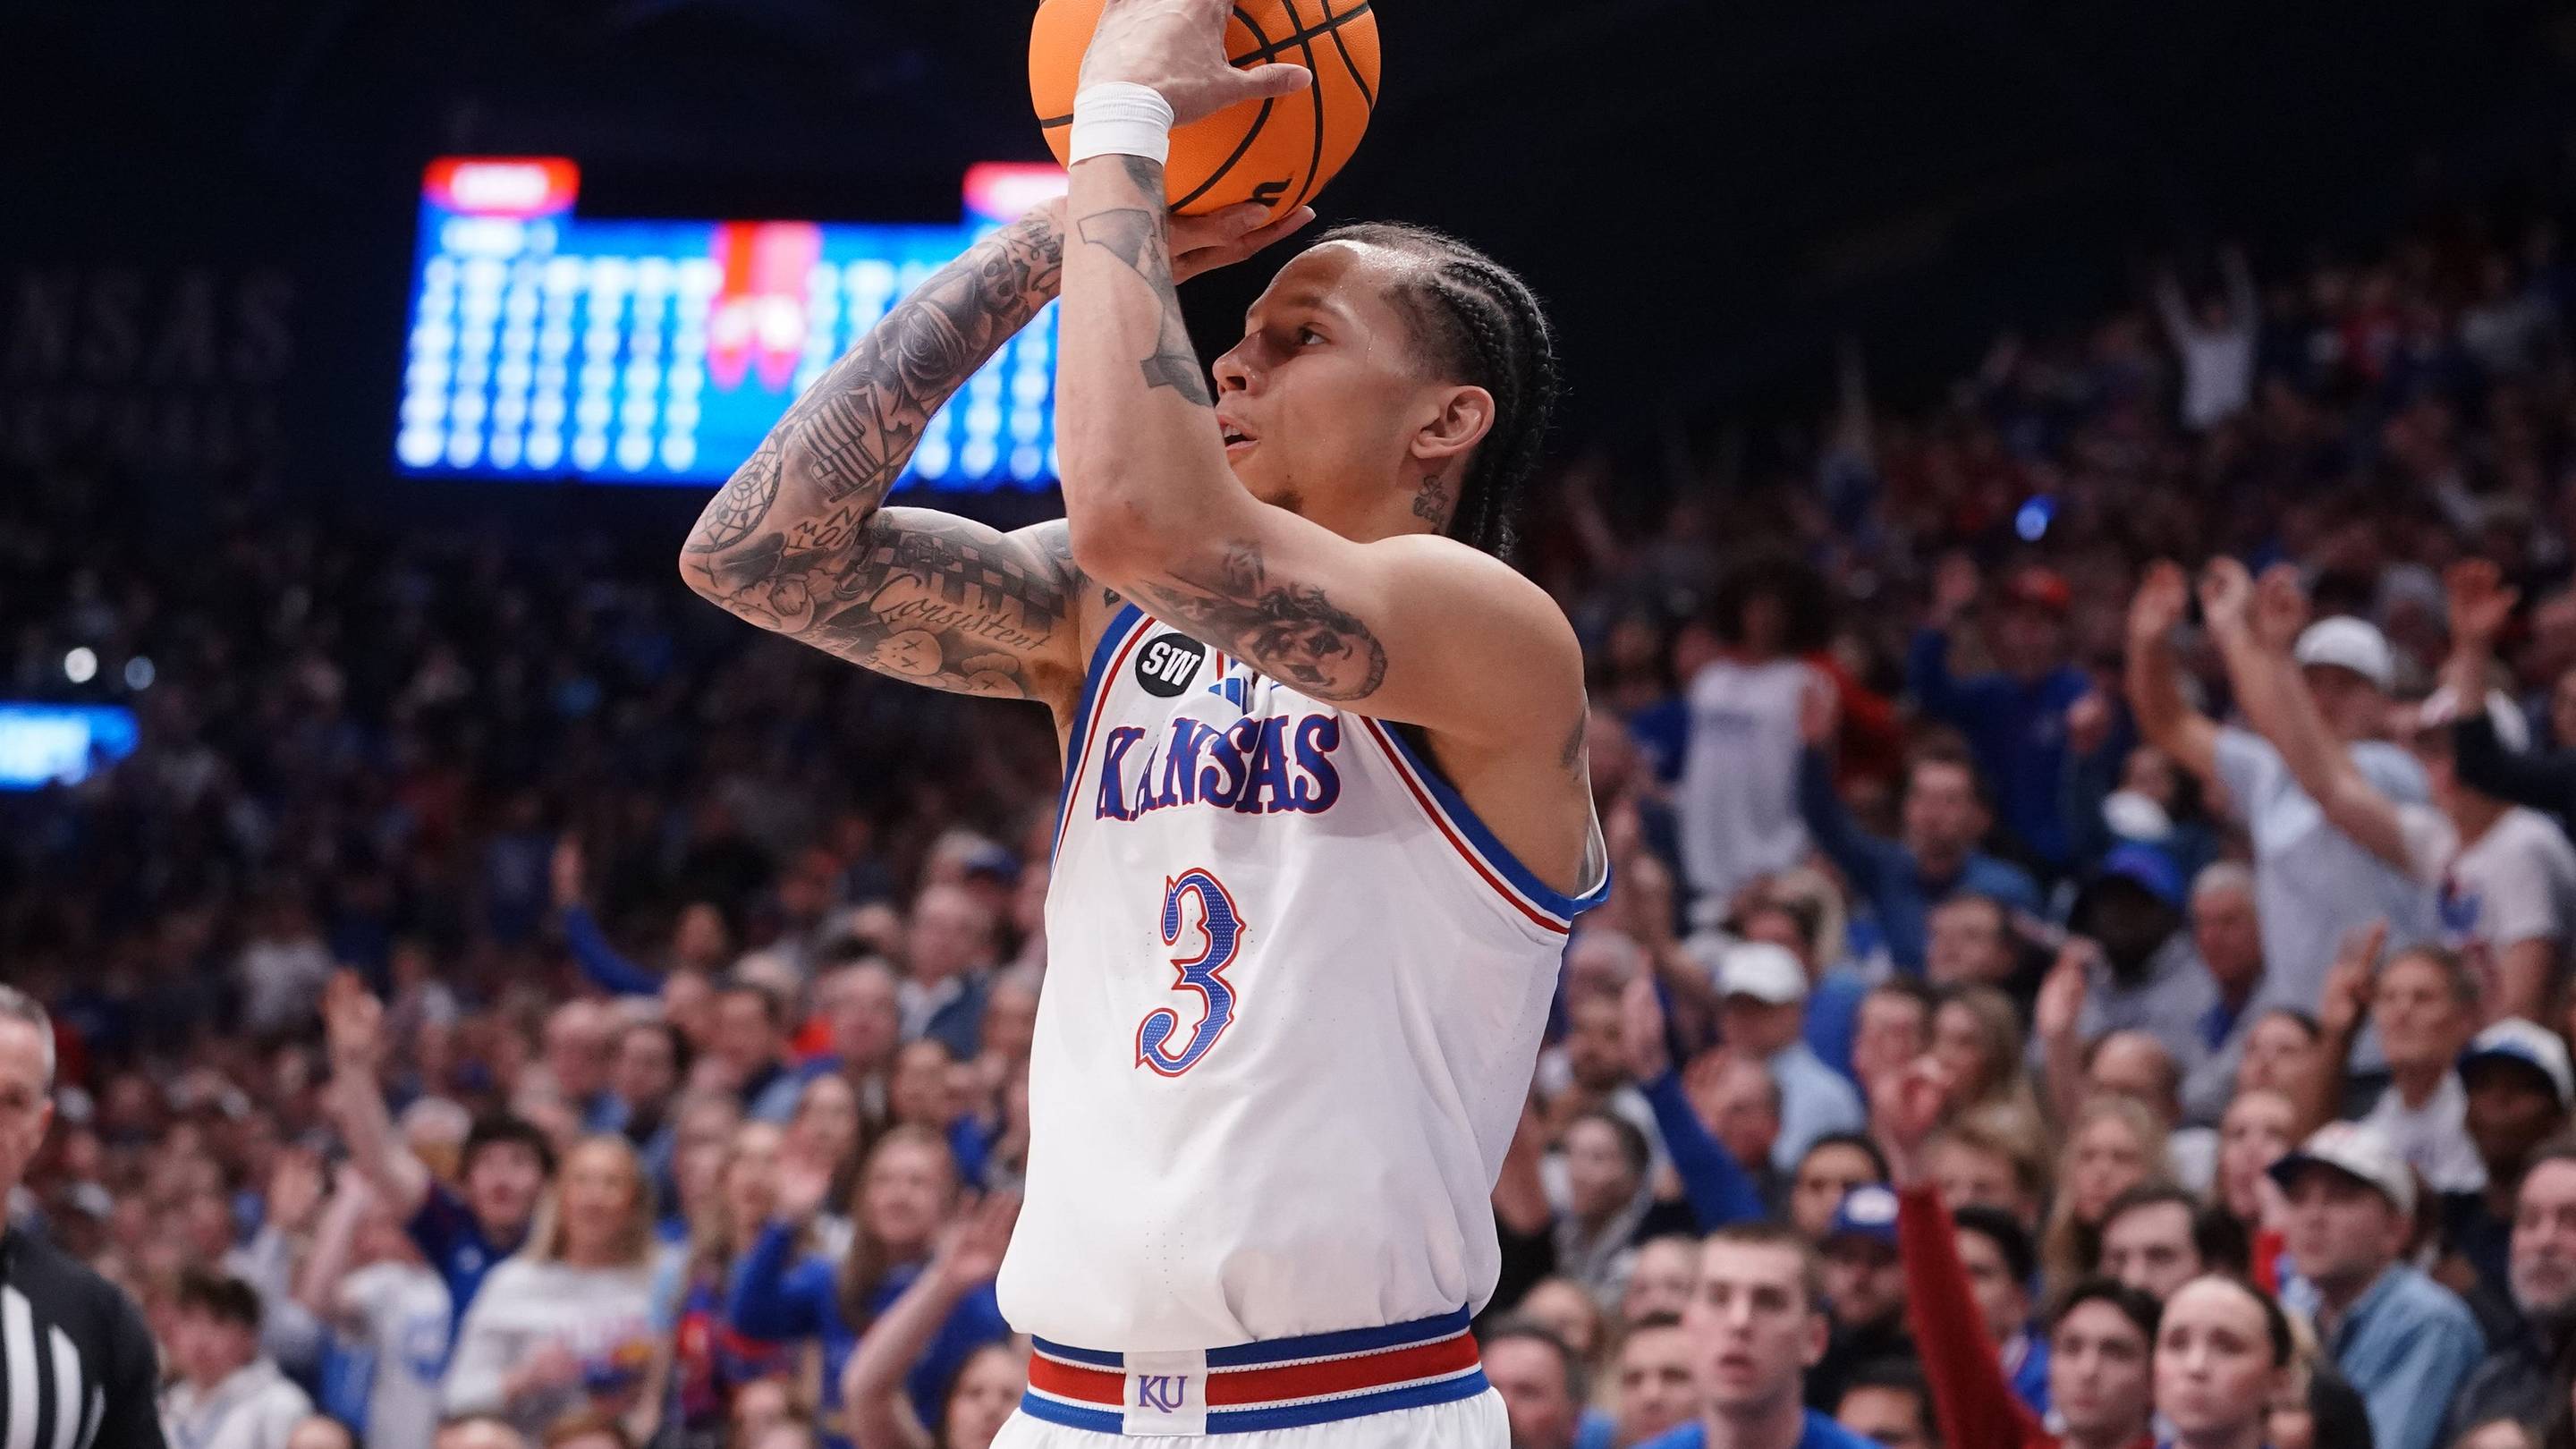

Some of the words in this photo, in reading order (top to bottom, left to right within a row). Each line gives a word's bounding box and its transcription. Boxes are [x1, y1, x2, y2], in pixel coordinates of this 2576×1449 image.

[869, 573, 1051, 651] Consistent
[1141, 641, 1201, 687] SW
[1096, 714, 1341, 822] KANSAS
[1135, 868, 1247, 1078] 3
[1138, 1375, 1189, 1413] KU
